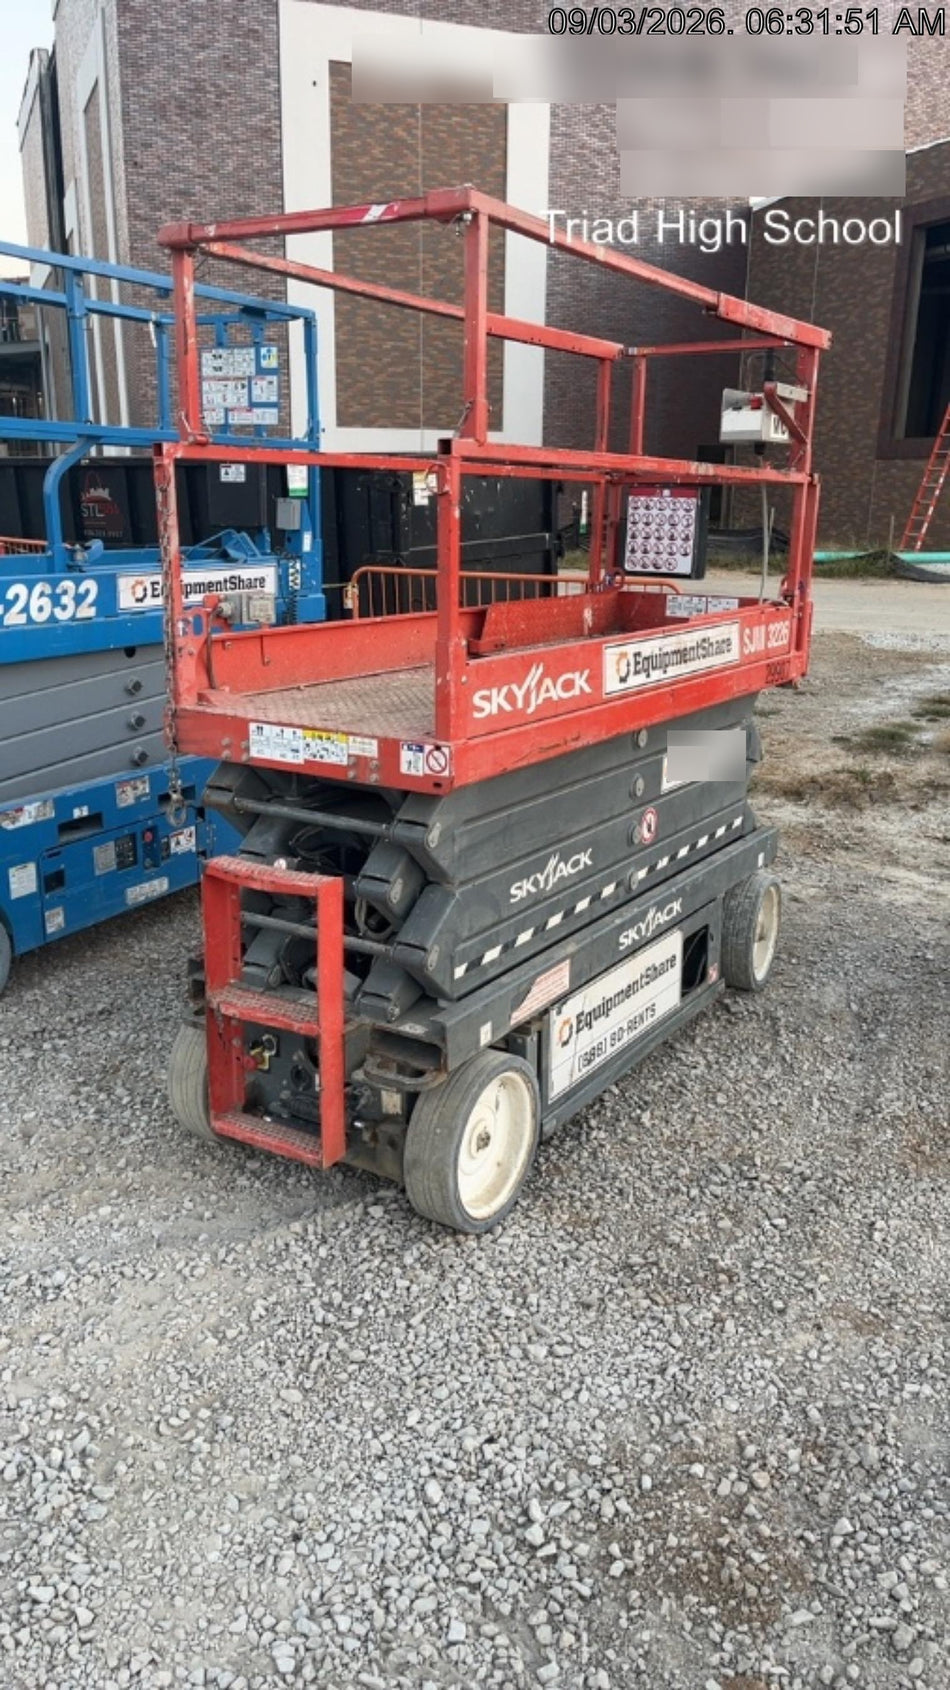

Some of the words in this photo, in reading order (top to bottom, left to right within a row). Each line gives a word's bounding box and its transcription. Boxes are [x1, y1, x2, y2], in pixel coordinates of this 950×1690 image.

[150, 574, 266, 600] EipmentShare
[632, 636, 733, 679] EquipmentShare
[472, 662, 593, 720] SKYJACK
[509, 848, 593, 904] SKYJACK
[618, 897, 683, 951] SKYJACK
[574, 952, 678, 1035] EquipmentShare
